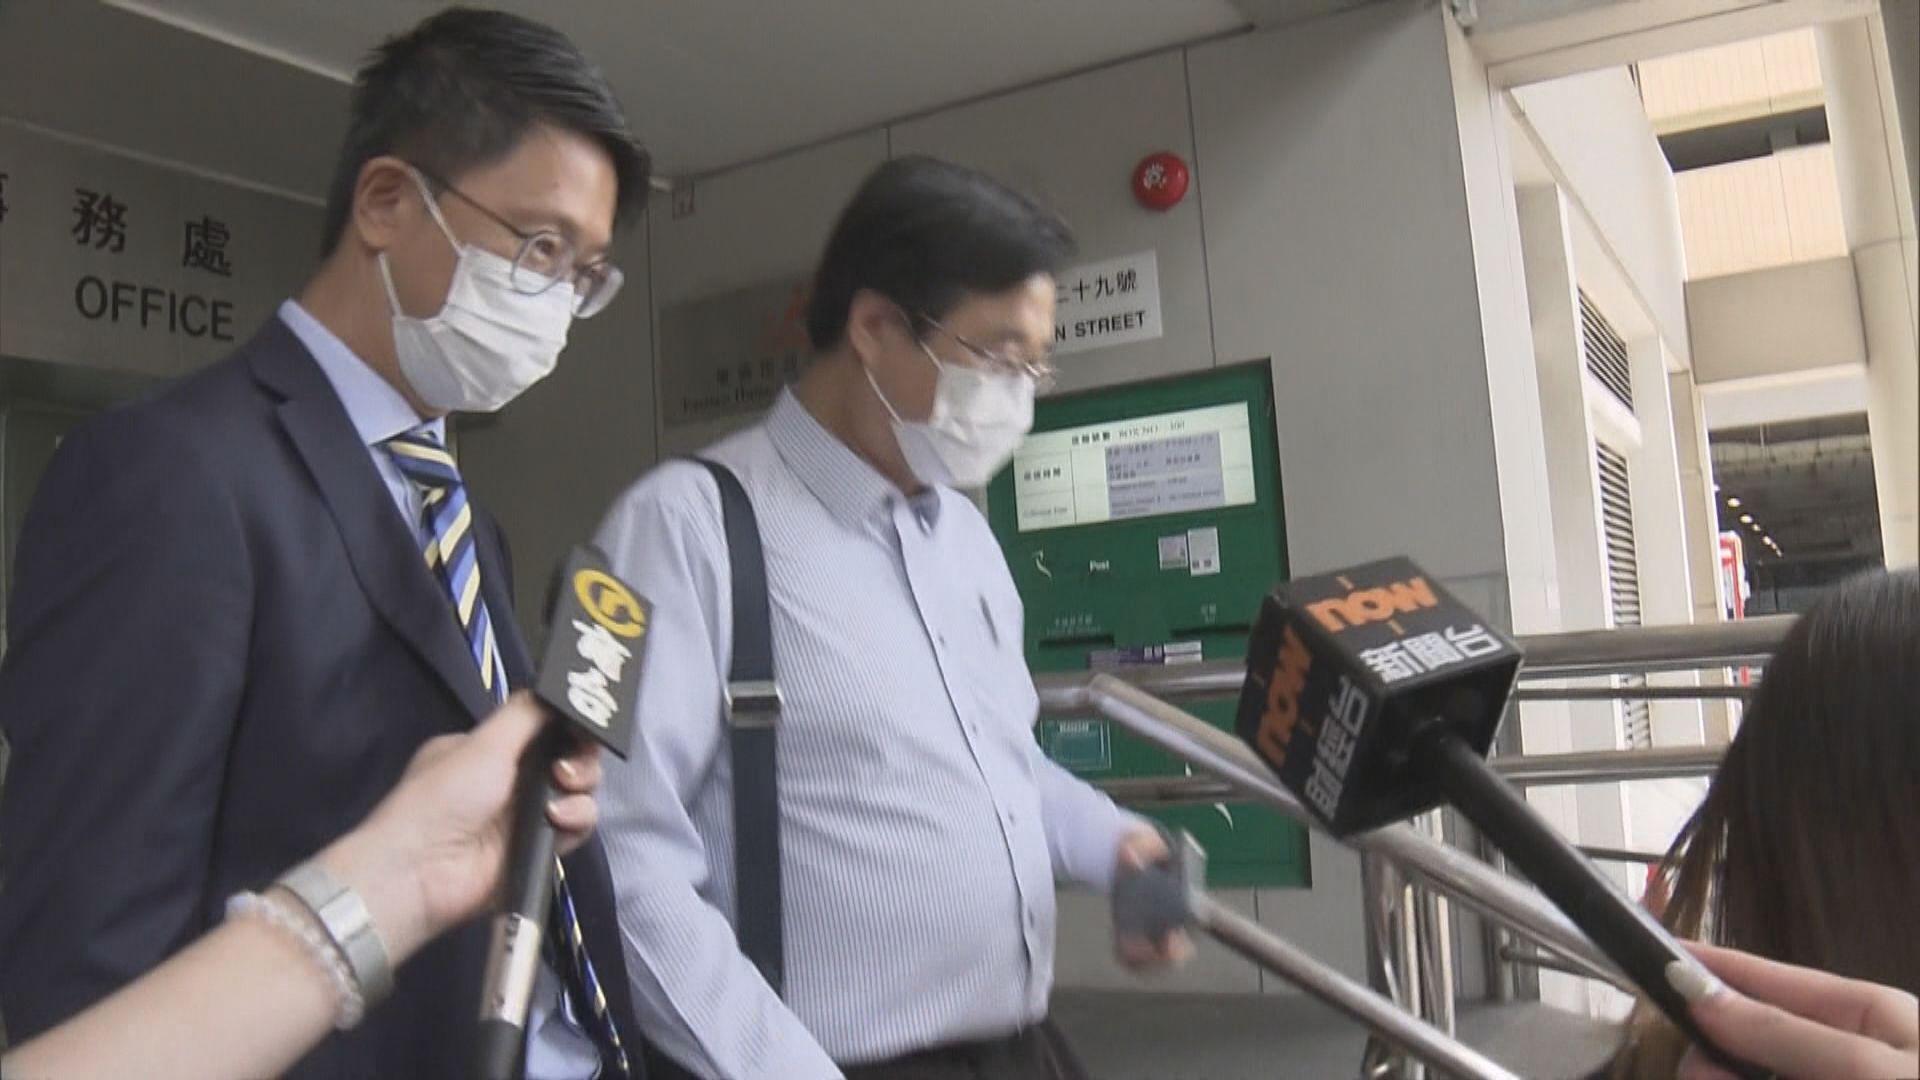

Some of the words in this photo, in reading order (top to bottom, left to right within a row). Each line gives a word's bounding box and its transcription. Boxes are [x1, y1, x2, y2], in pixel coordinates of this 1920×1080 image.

[0, 172, 232, 278] 務處
[75, 275, 235, 342] OFFICE
[1055, 323, 1066, 342] N
[1074, 310, 1146, 338] STREET
[1089, 559, 1110, 573] Post
[1304, 576, 1438, 633] now
[1359, 624, 1502, 684] 新聞台
[1256, 624, 1312, 768] now
